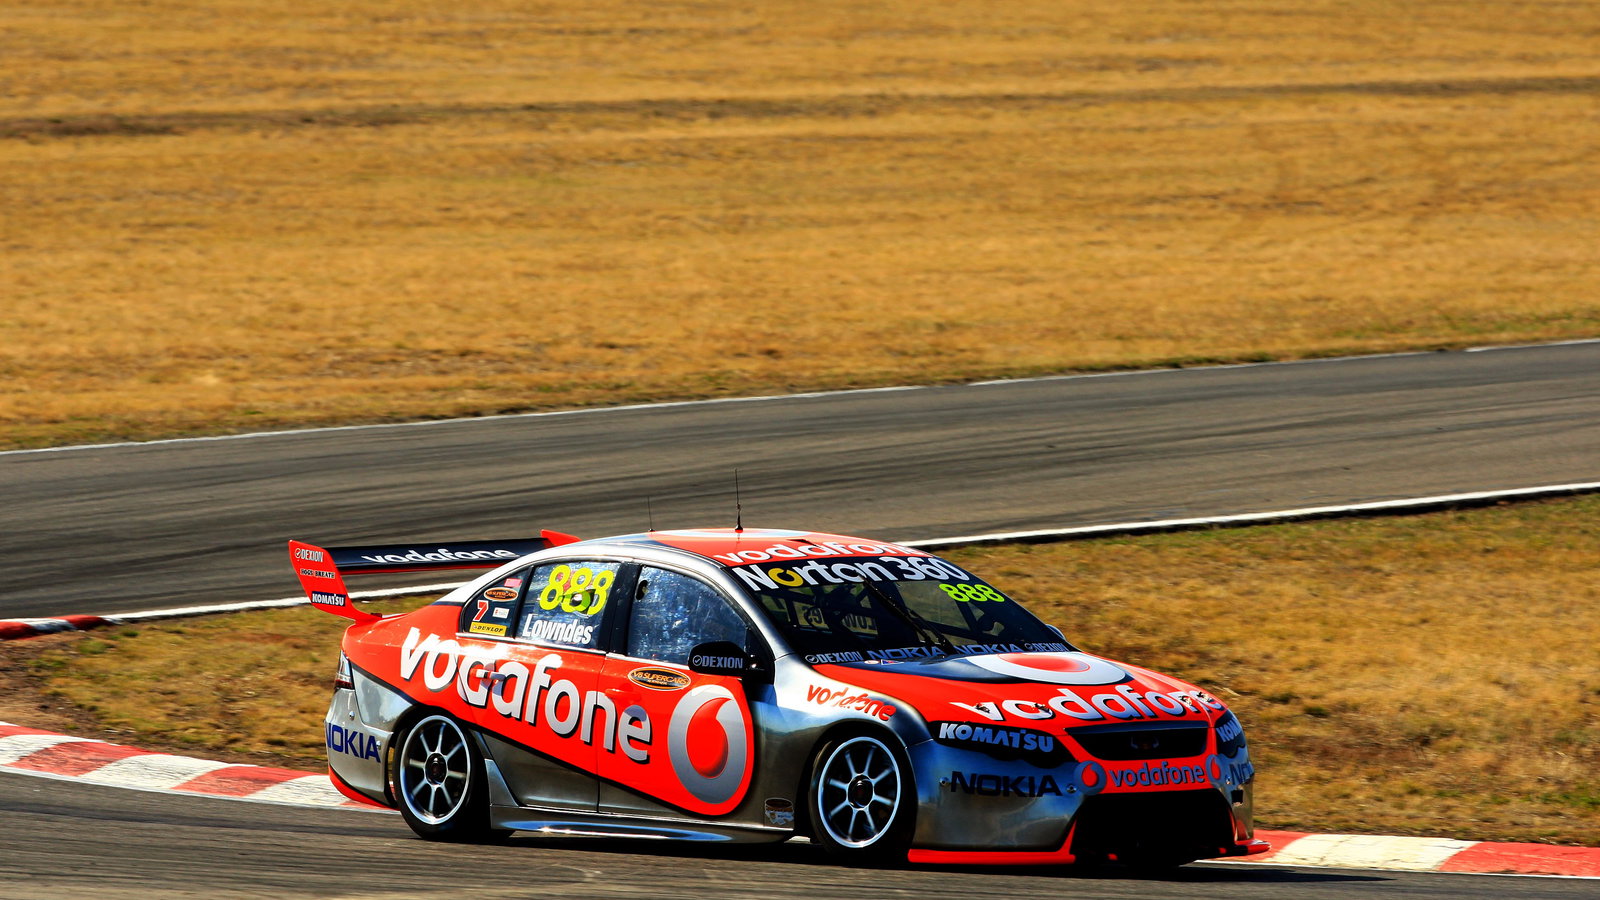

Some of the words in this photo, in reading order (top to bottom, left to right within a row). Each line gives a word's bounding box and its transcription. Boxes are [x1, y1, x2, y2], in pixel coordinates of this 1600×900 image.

[301, 549, 324, 563] DEXION
[361, 548, 520, 563] vodafone
[732, 560, 898, 592] Norton
[879, 556, 970, 581] 360
[312, 593, 345, 606] KOMATSU
[539, 564, 614, 615] 888
[938, 583, 1005, 602] 888
[473, 600, 489, 621] 7
[477, 625, 504, 633] DUNLOP
[522, 613, 594, 645] Lowndes
[702, 655, 743, 669] DEXION
[816, 650, 864, 663] DEXION
[866, 646, 947, 660] NOKIA
[953, 643, 1024, 655] NOKIA
[643, 672, 688, 684] SUPERCARS
[400, 627, 652, 762] vodafone
[807, 685, 896, 721] vodafone
[949, 684, 1222, 720] vodafone
[326, 723, 381, 763] NOKIA
[938, 723, 1054, 752] KOMATSU
[950, 771, 1063, 797] NOKIA
[1109, 761, 1206, 787] vodafone
